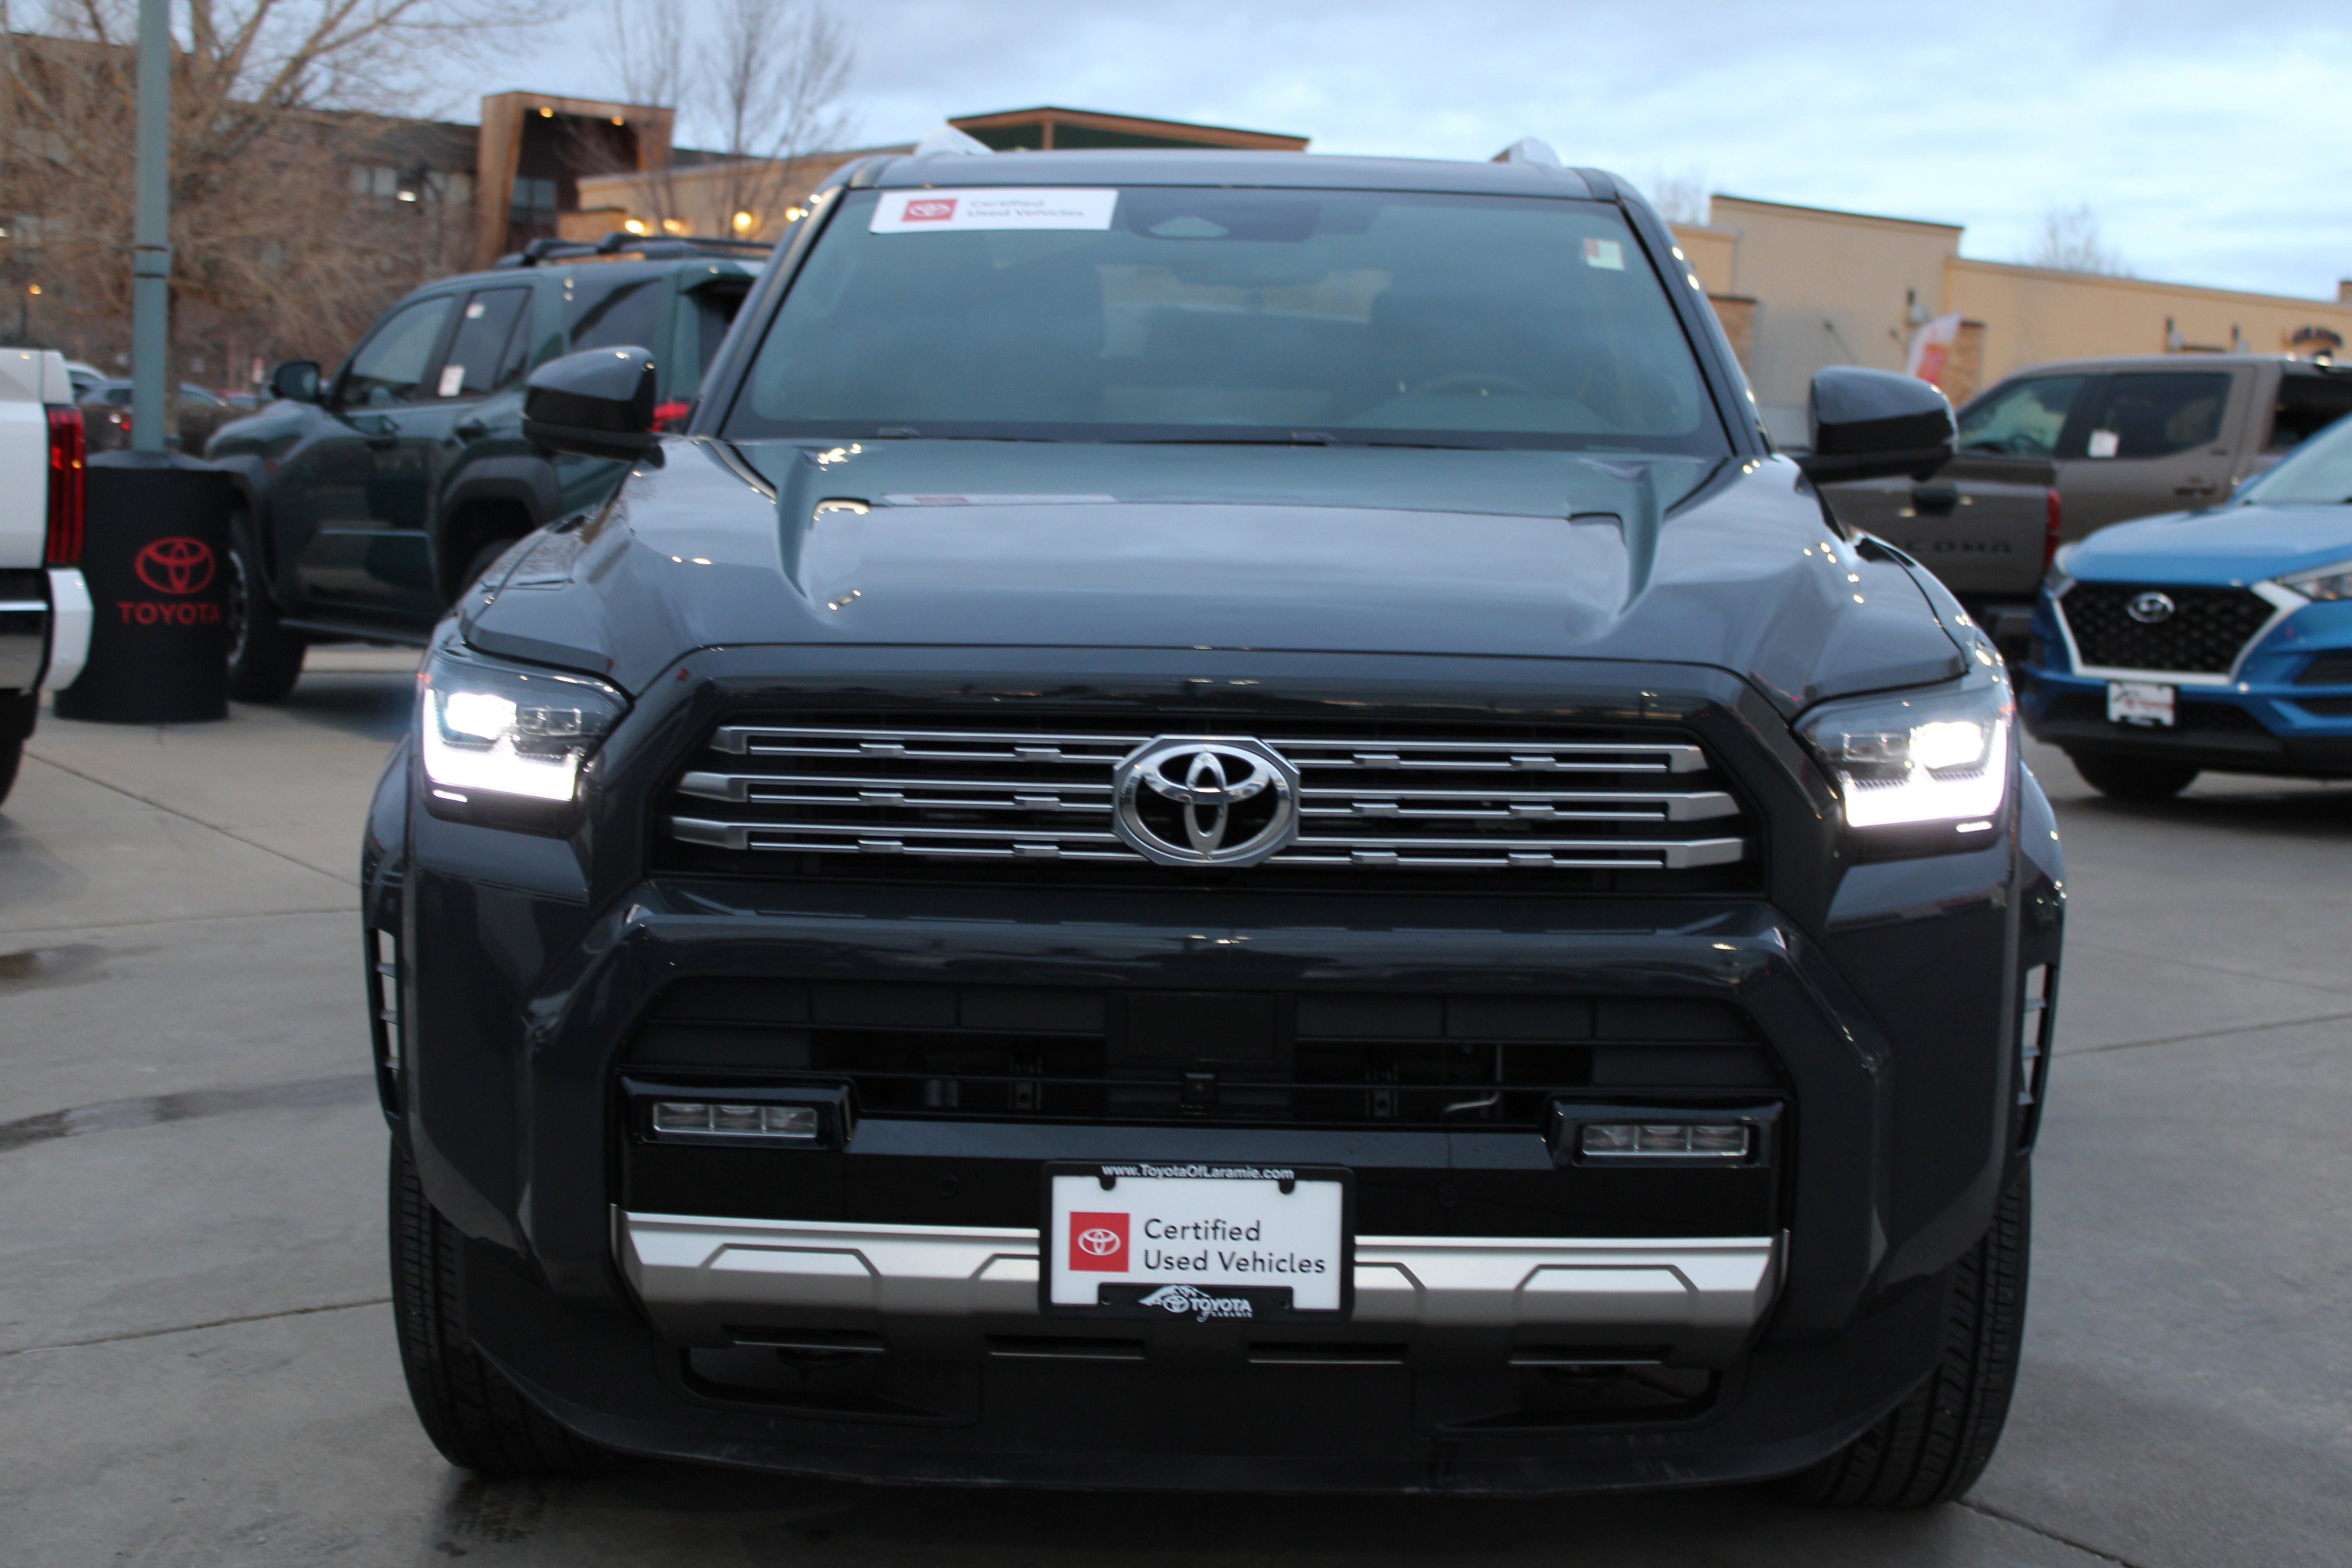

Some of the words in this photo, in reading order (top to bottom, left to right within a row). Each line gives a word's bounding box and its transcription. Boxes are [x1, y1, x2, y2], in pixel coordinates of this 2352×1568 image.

[116, 601, 221, 625] TOYOTA
[1101, 1164, 1295, 1180] www.ToyotaOfLaramie.com
[1144, 1218, 1261, 1241] Certified
[1144, 1250, 1208, 1271] Used
[1217, 1250, 1326, 1273] Vehicles
[1189, 1297, 1253, 1312] TOYOTA
